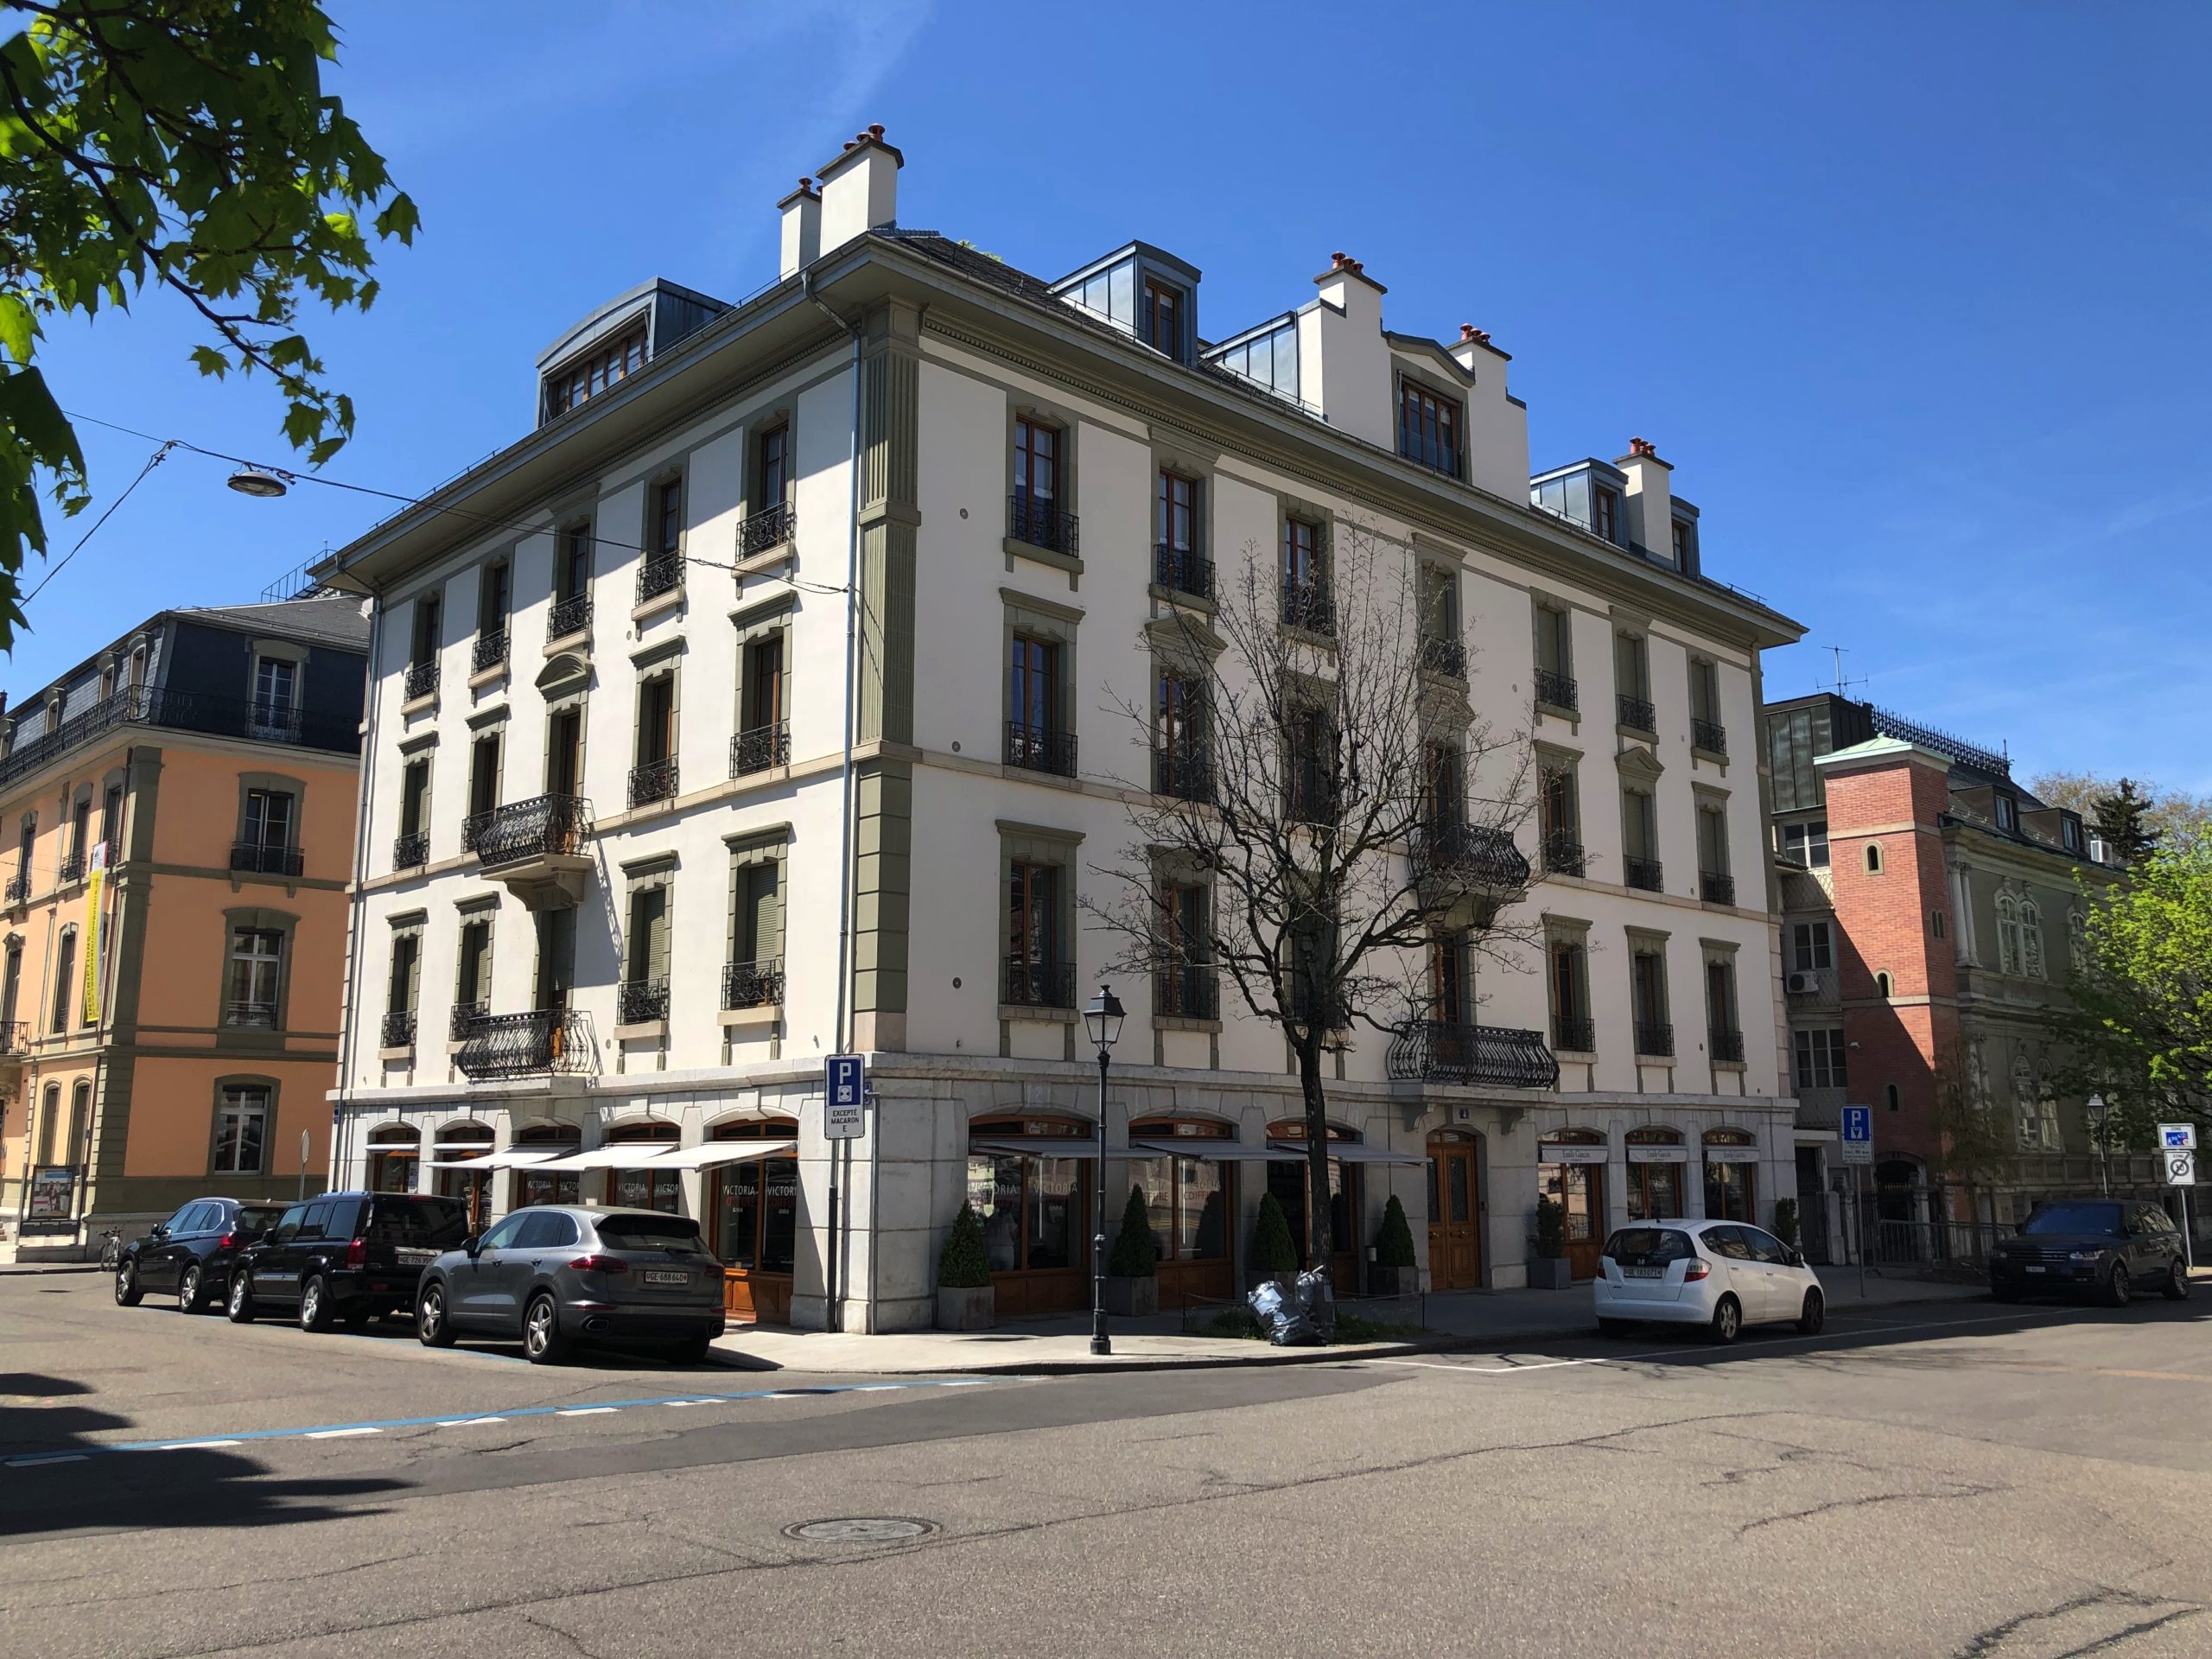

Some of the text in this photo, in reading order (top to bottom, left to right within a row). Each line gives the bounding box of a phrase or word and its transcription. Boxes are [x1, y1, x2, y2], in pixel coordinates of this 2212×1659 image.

[839, 1062, 852, 1084] P
[832, 1108, 858, 1117] EXCEPTÉ
[830, 1116, 860, 1125] MACARON
[1851, 1110, 1862, 1127] P
[2175, 1163, 2185, 1173] 30
[617, 1182, 645, 1192] VICTORIA
[722, 1185, 755, 1196] VICTORIA
[1033, 1182, 1078, 1194] VCTORIA
